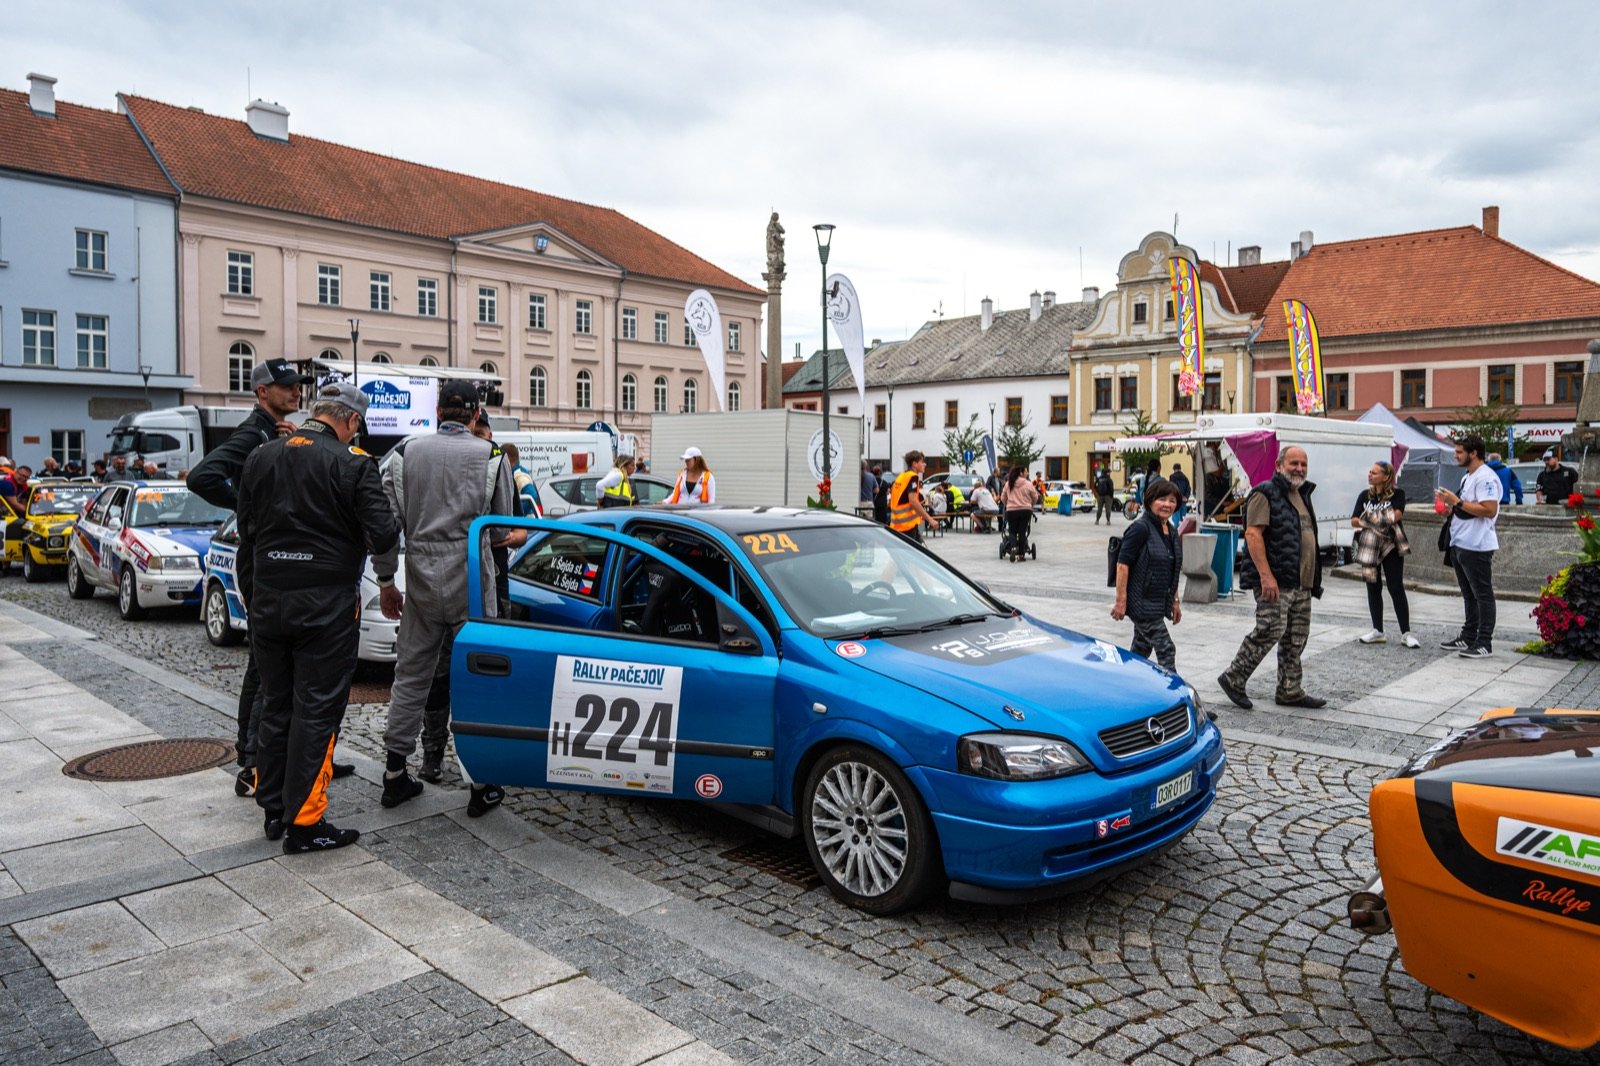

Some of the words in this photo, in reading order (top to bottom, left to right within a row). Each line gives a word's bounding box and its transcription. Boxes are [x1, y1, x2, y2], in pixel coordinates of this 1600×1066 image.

[375, 391, 409, 405] PAČEJOV
[743, 533, 800, 555] 224
[209, 553, 234, 570] SUZUKI
[556, 556, 575, 574] Šejda
[561, 574, 579, 591] Šejda
[572, 659, 609, 680] RALLY
[610, 665, 665, 686] PAČEJOV
[1547, 855, 1561, 863] ALL
[1564, 860, 1581, 868] FOR
[1522, 880, 1591, 914] Rallye
